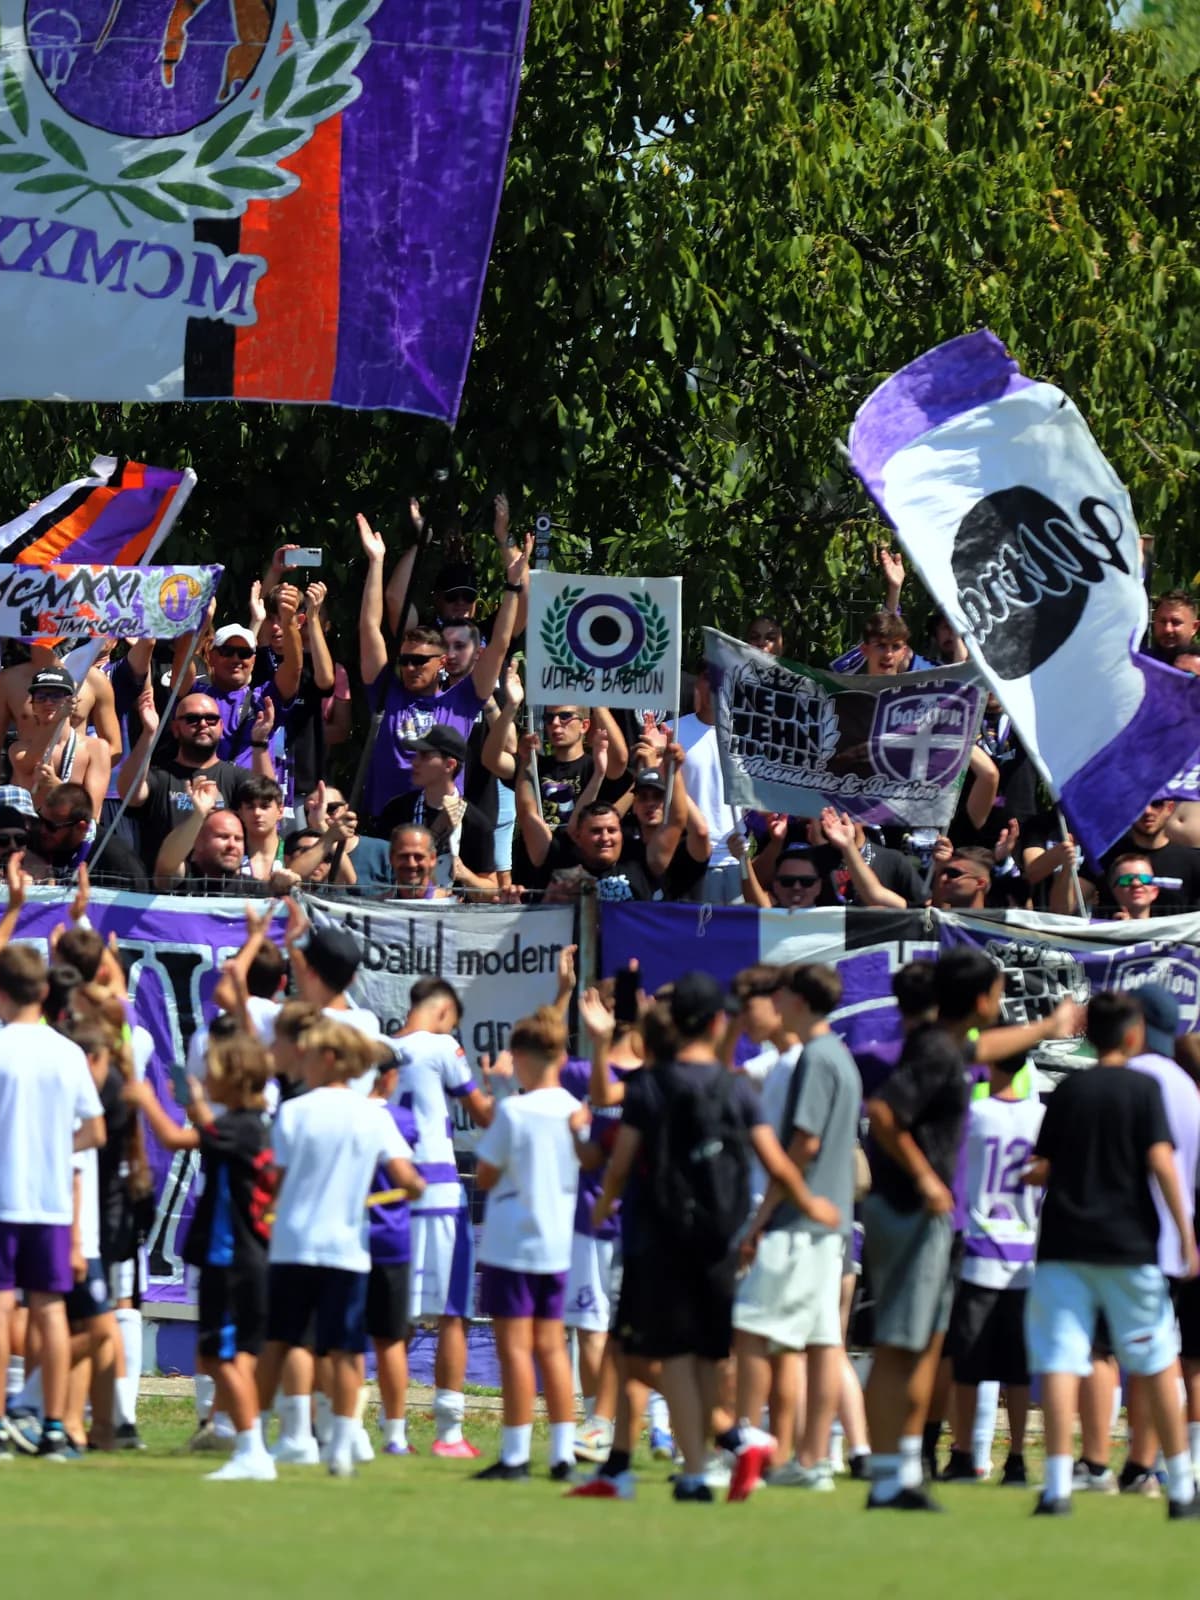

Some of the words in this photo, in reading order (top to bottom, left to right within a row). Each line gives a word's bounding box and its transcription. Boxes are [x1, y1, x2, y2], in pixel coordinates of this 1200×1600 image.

[541, 664, 596, 692] ULTRAS
[601, 667, 664, 694] BASTION
[732, 682, 823, 724] NEUN
[984, 1137, 1034, 1194] 12
